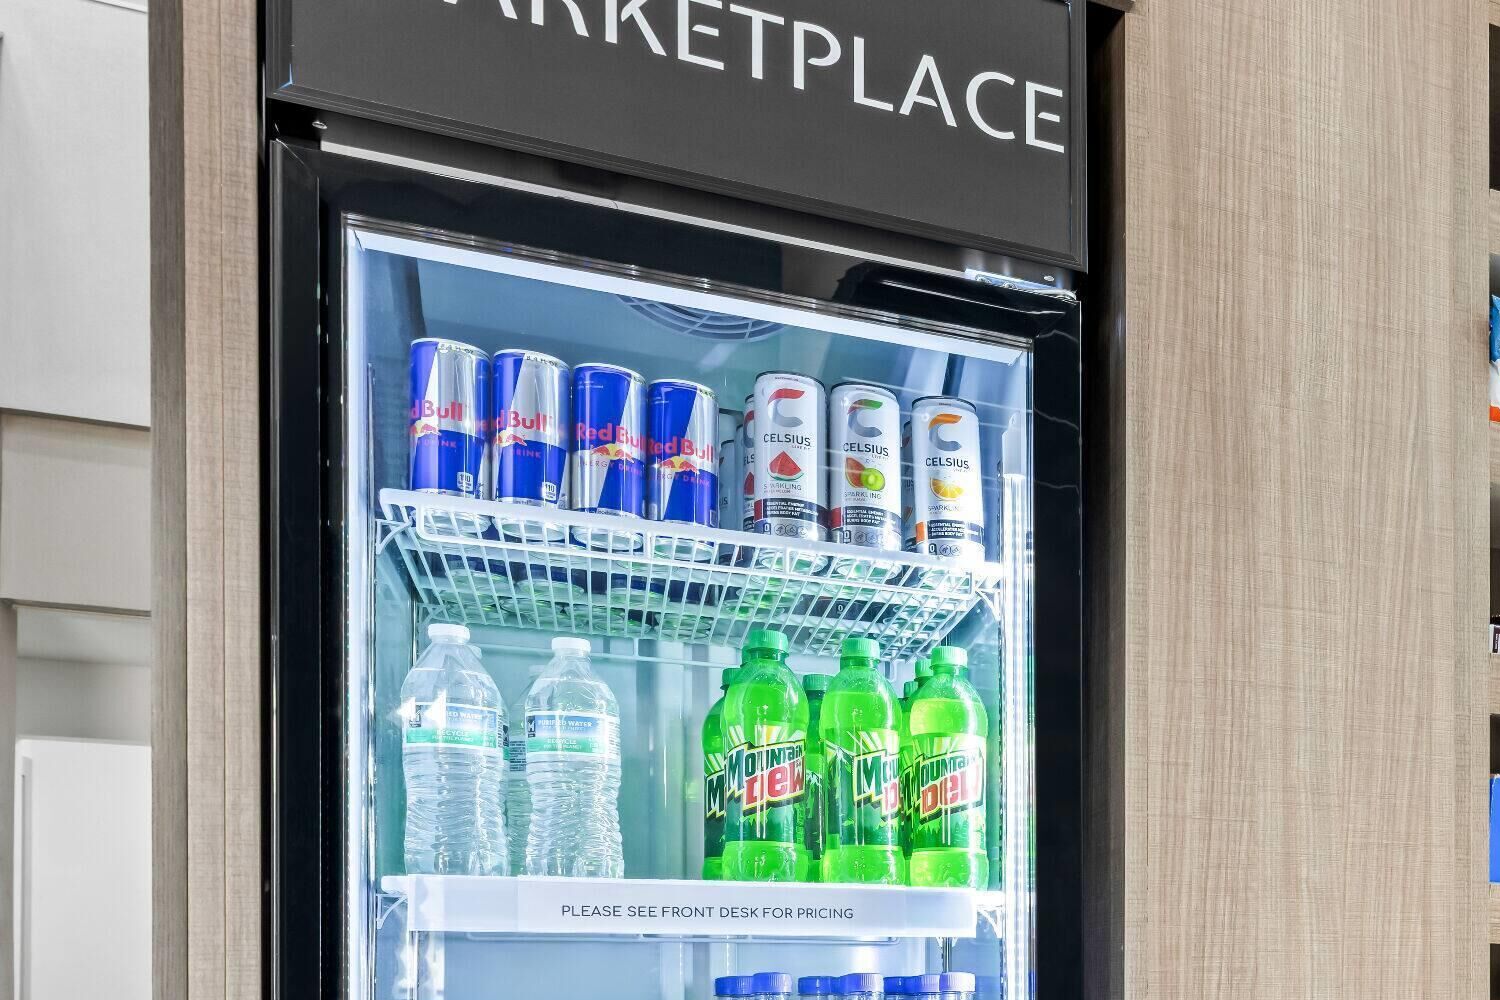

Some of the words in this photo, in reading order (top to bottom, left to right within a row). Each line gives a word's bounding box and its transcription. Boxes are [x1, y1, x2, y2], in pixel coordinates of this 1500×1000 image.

[444, 0, 1065, 153] KETPLACE
[422, 400, 462, 421] Bull
[508, 410, 546, 432] Bull
[575, 422, 612, 441] Red
[763, 433, 811, 447] CELSIUS
[681, 438, 713, 463] Bull
[843, 442, 889, 457] CELSIUS
[925, 457, 969, 470] CELSIUS
[764, 483, 802, 491] SARKLING
[538, 719, 567, 727] PURIFED
[568, 720, 593, 728] WATER
[562, 905, 622, 917] PLEASE
[628, 906, 657, 917] SEE
[662, 907, 714, 918] FRONT
[719, 907, 759, 918] DESK
[763, 907, 793, 918] FOR
[797, 908, 854, 919] PRICING
